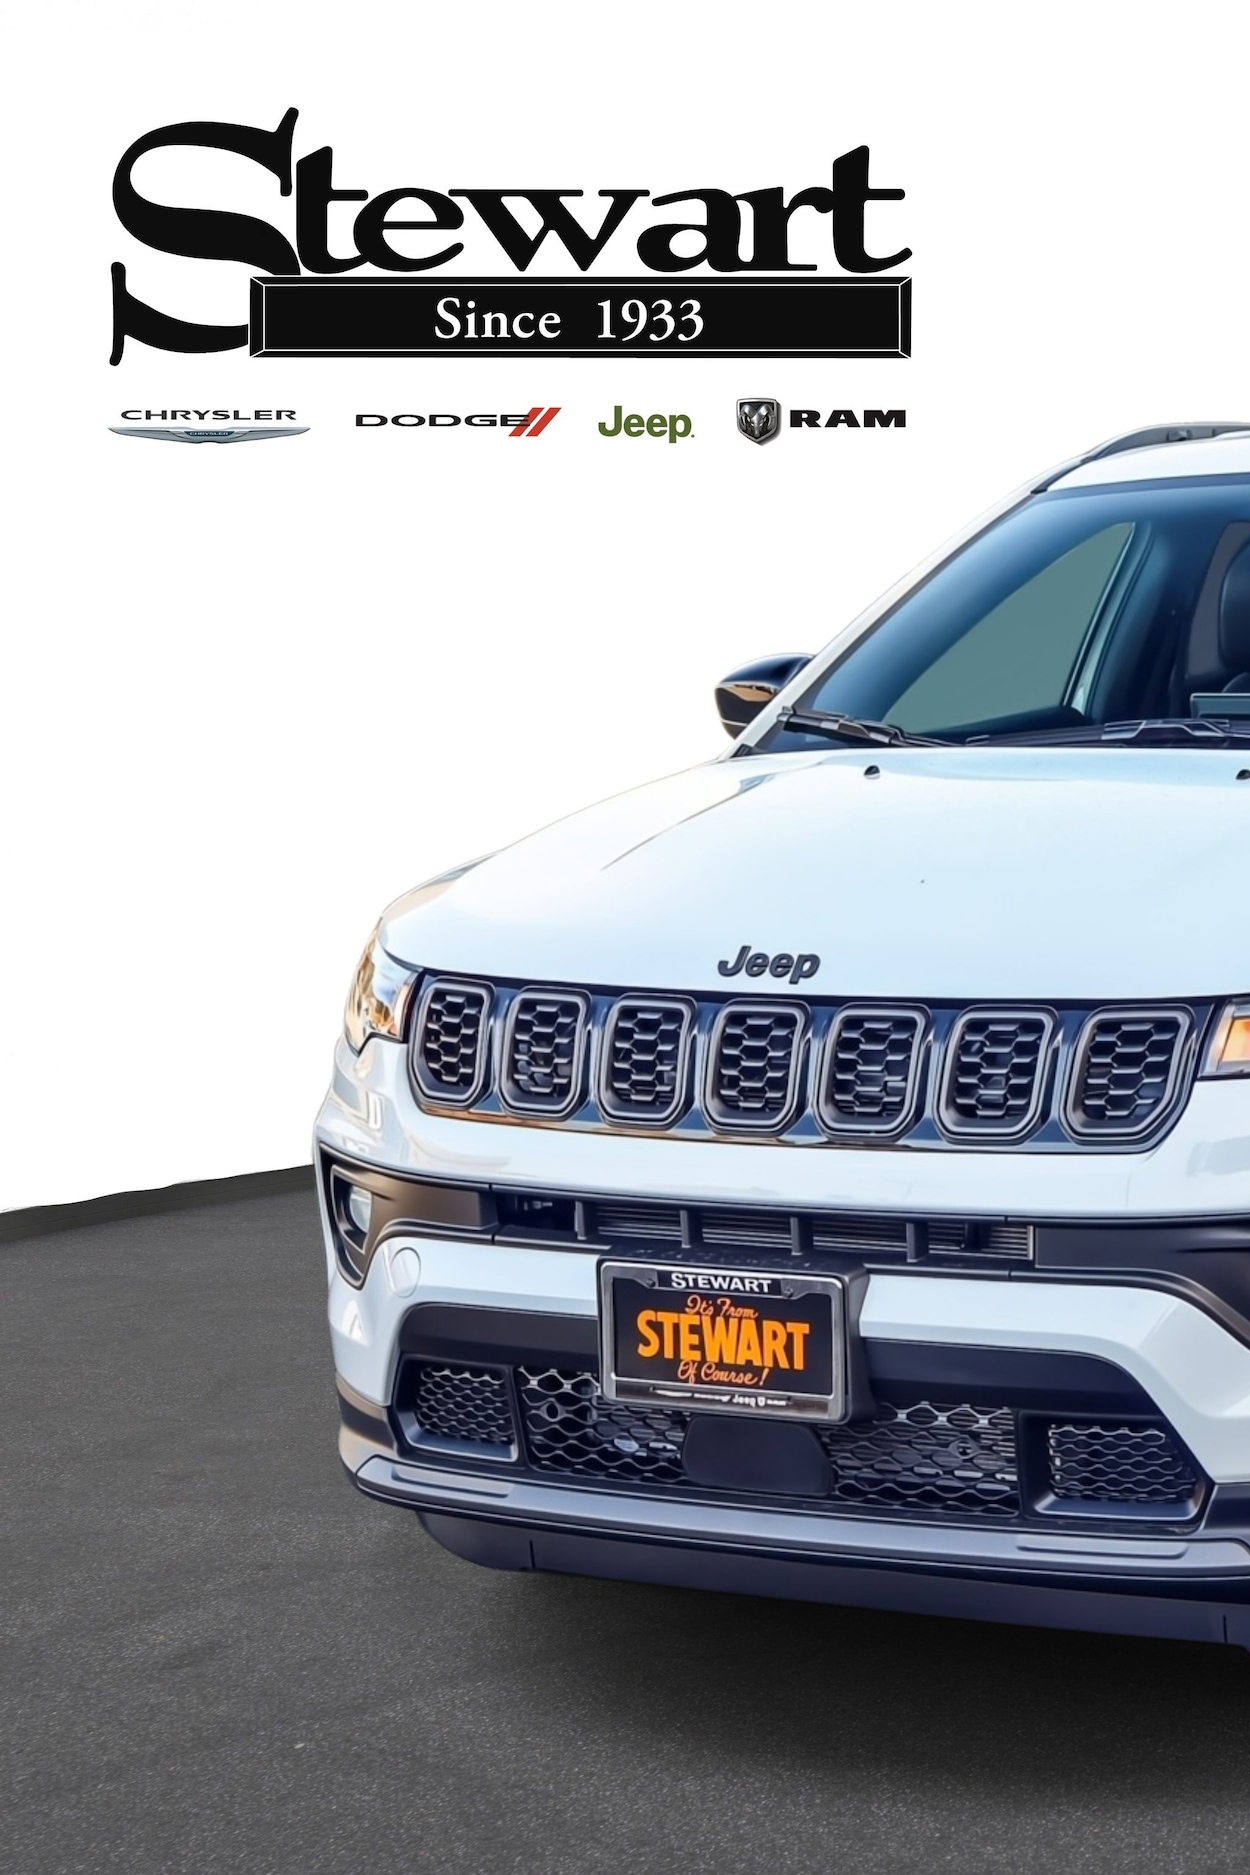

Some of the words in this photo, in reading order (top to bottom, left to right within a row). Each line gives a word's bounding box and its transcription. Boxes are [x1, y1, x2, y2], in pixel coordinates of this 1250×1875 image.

[717, 945, 821, 985] Jeep
[670, 1272, 772, 1294] STEWART
[684, 1294, 714, 1317] It's
[716, 1297, 759, 1319] From
[636, 1309, 810, 1370] STEWART
[677, 1360, 698, 1385] Of
